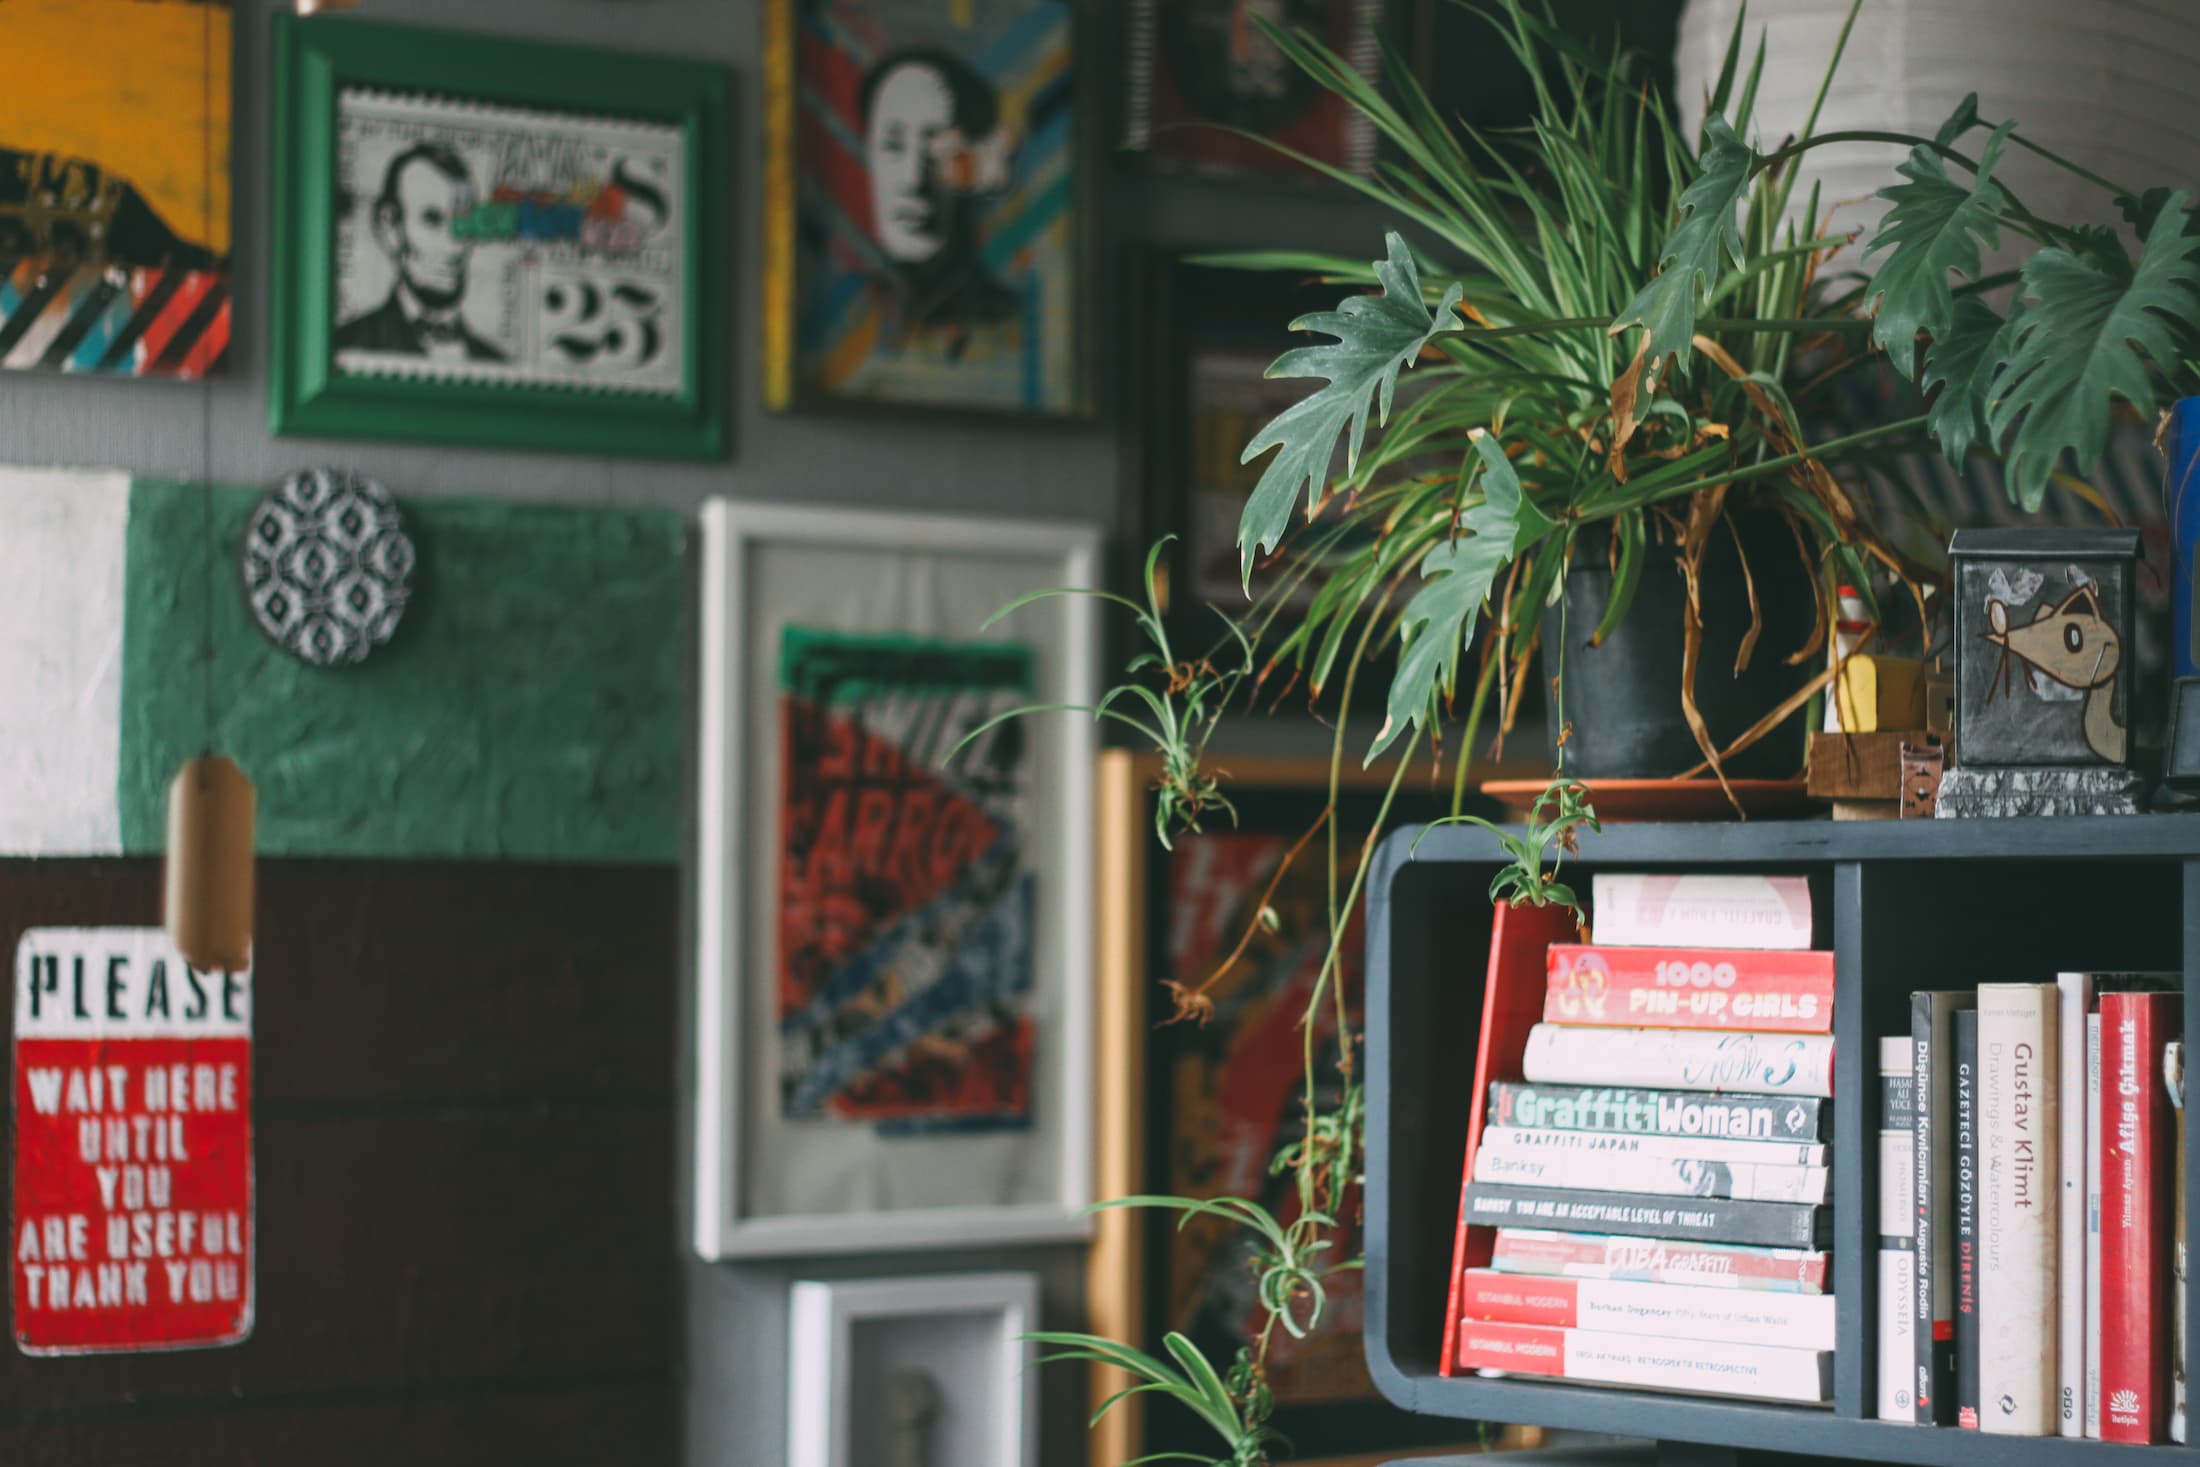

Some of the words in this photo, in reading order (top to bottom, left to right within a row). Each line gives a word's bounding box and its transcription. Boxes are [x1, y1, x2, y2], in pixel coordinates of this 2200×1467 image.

[30, 954, 244, 1019] PLEASE
[1655, 961, 1737, 988] 1000
[1629, 988, 1729, 1015] PIN-UP
[1732, 993, 1818, 1018] GIRLS
[27, 1066, 130, 1114] WAIT
[145, 1064, 238, 1112] HERE
[1915, 1041, 1929, 1112] Düşünce
[1986, 1042, 2002, 1129] Drawings
[2014, 1042, 2033, 1131] Gustav
[79, 1115, 188, 1163] UNTIL
[1513, 1132, 1583, 1147] GRAFFITI
[1589, 1138, 1640, 1152] JAPAN
[1990, 1135, 2002, 1150] &
[97, 1165, 171, 1210] YOU
[1491, 1156, 1546, 1176] Banksy
[2014, 1140, 2034, 1209] Klimt
[1630, 1207, 1661, 1225] LEVEL
[1678, 1211, 1716, 1228] THREAT
[1960, 1155, 1973, 1236] GÖZÜYLE
[1988, 1153, 2002, 1272] Watercolours
[18, 1214, 89, 1263] ARE
[107, 1211, 244, 1258] USEFUL
[1917, 1218, 1929, 1276] Auguste
[24, 1262, 148, 1310] THANK
[165, 1258, 239, 1303] YOU
[1919, 1280, 1929, 1320] Rodin
[1960, 1242, 1974, 1314] DİRENİŞ
